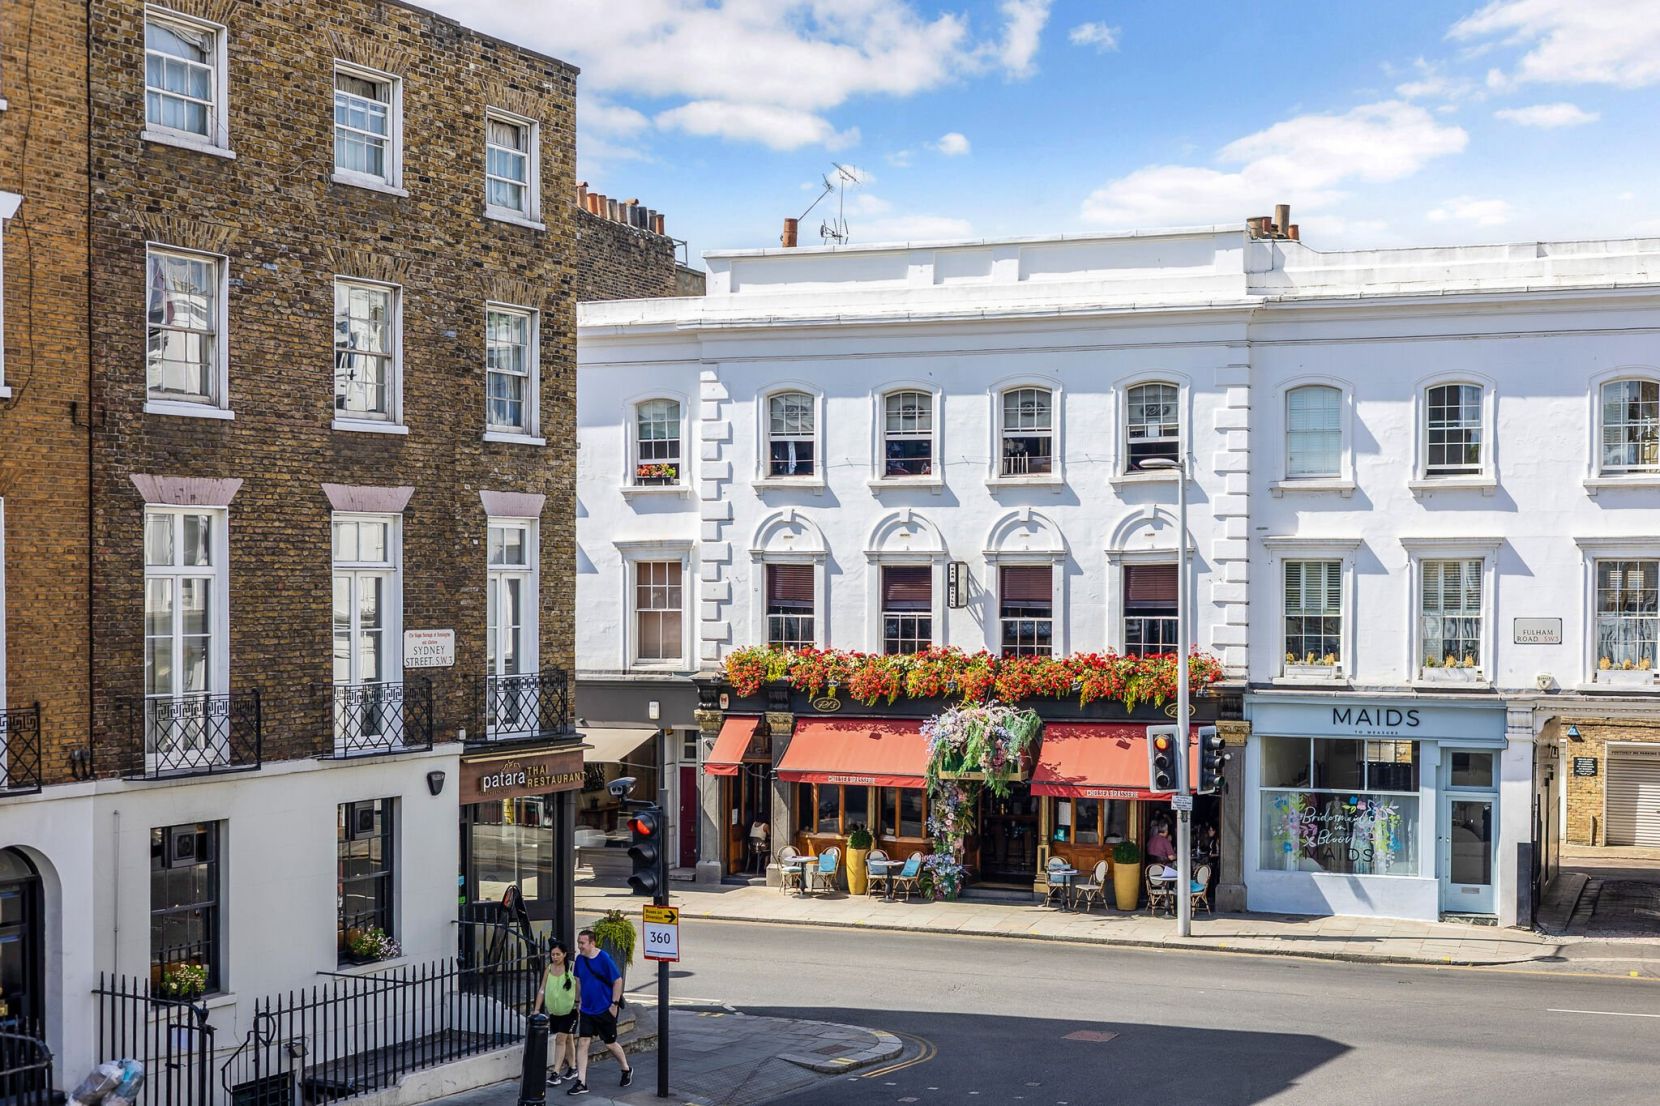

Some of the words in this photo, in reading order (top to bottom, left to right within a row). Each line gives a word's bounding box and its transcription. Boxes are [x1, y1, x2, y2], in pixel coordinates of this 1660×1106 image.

[413, 645, 445, 656] SYDNEY
[1332, 707, 1420, 727] MAIDS
[527, 765, 549, 776] THAI
[482, 770, 526, 793] patara
[527, 771, 586, 788] RESTAURANT
[828, 775, 851, 783] CHELSEA
[851, 776, 875, 785] BRASSERIE
[1110, 790, 1138, 798] BRASSERIE
[1334, 823, 1346, 831] in
[1304, 847, 1375, 863] MAIDS
[650, 932, 670, 944] 360
